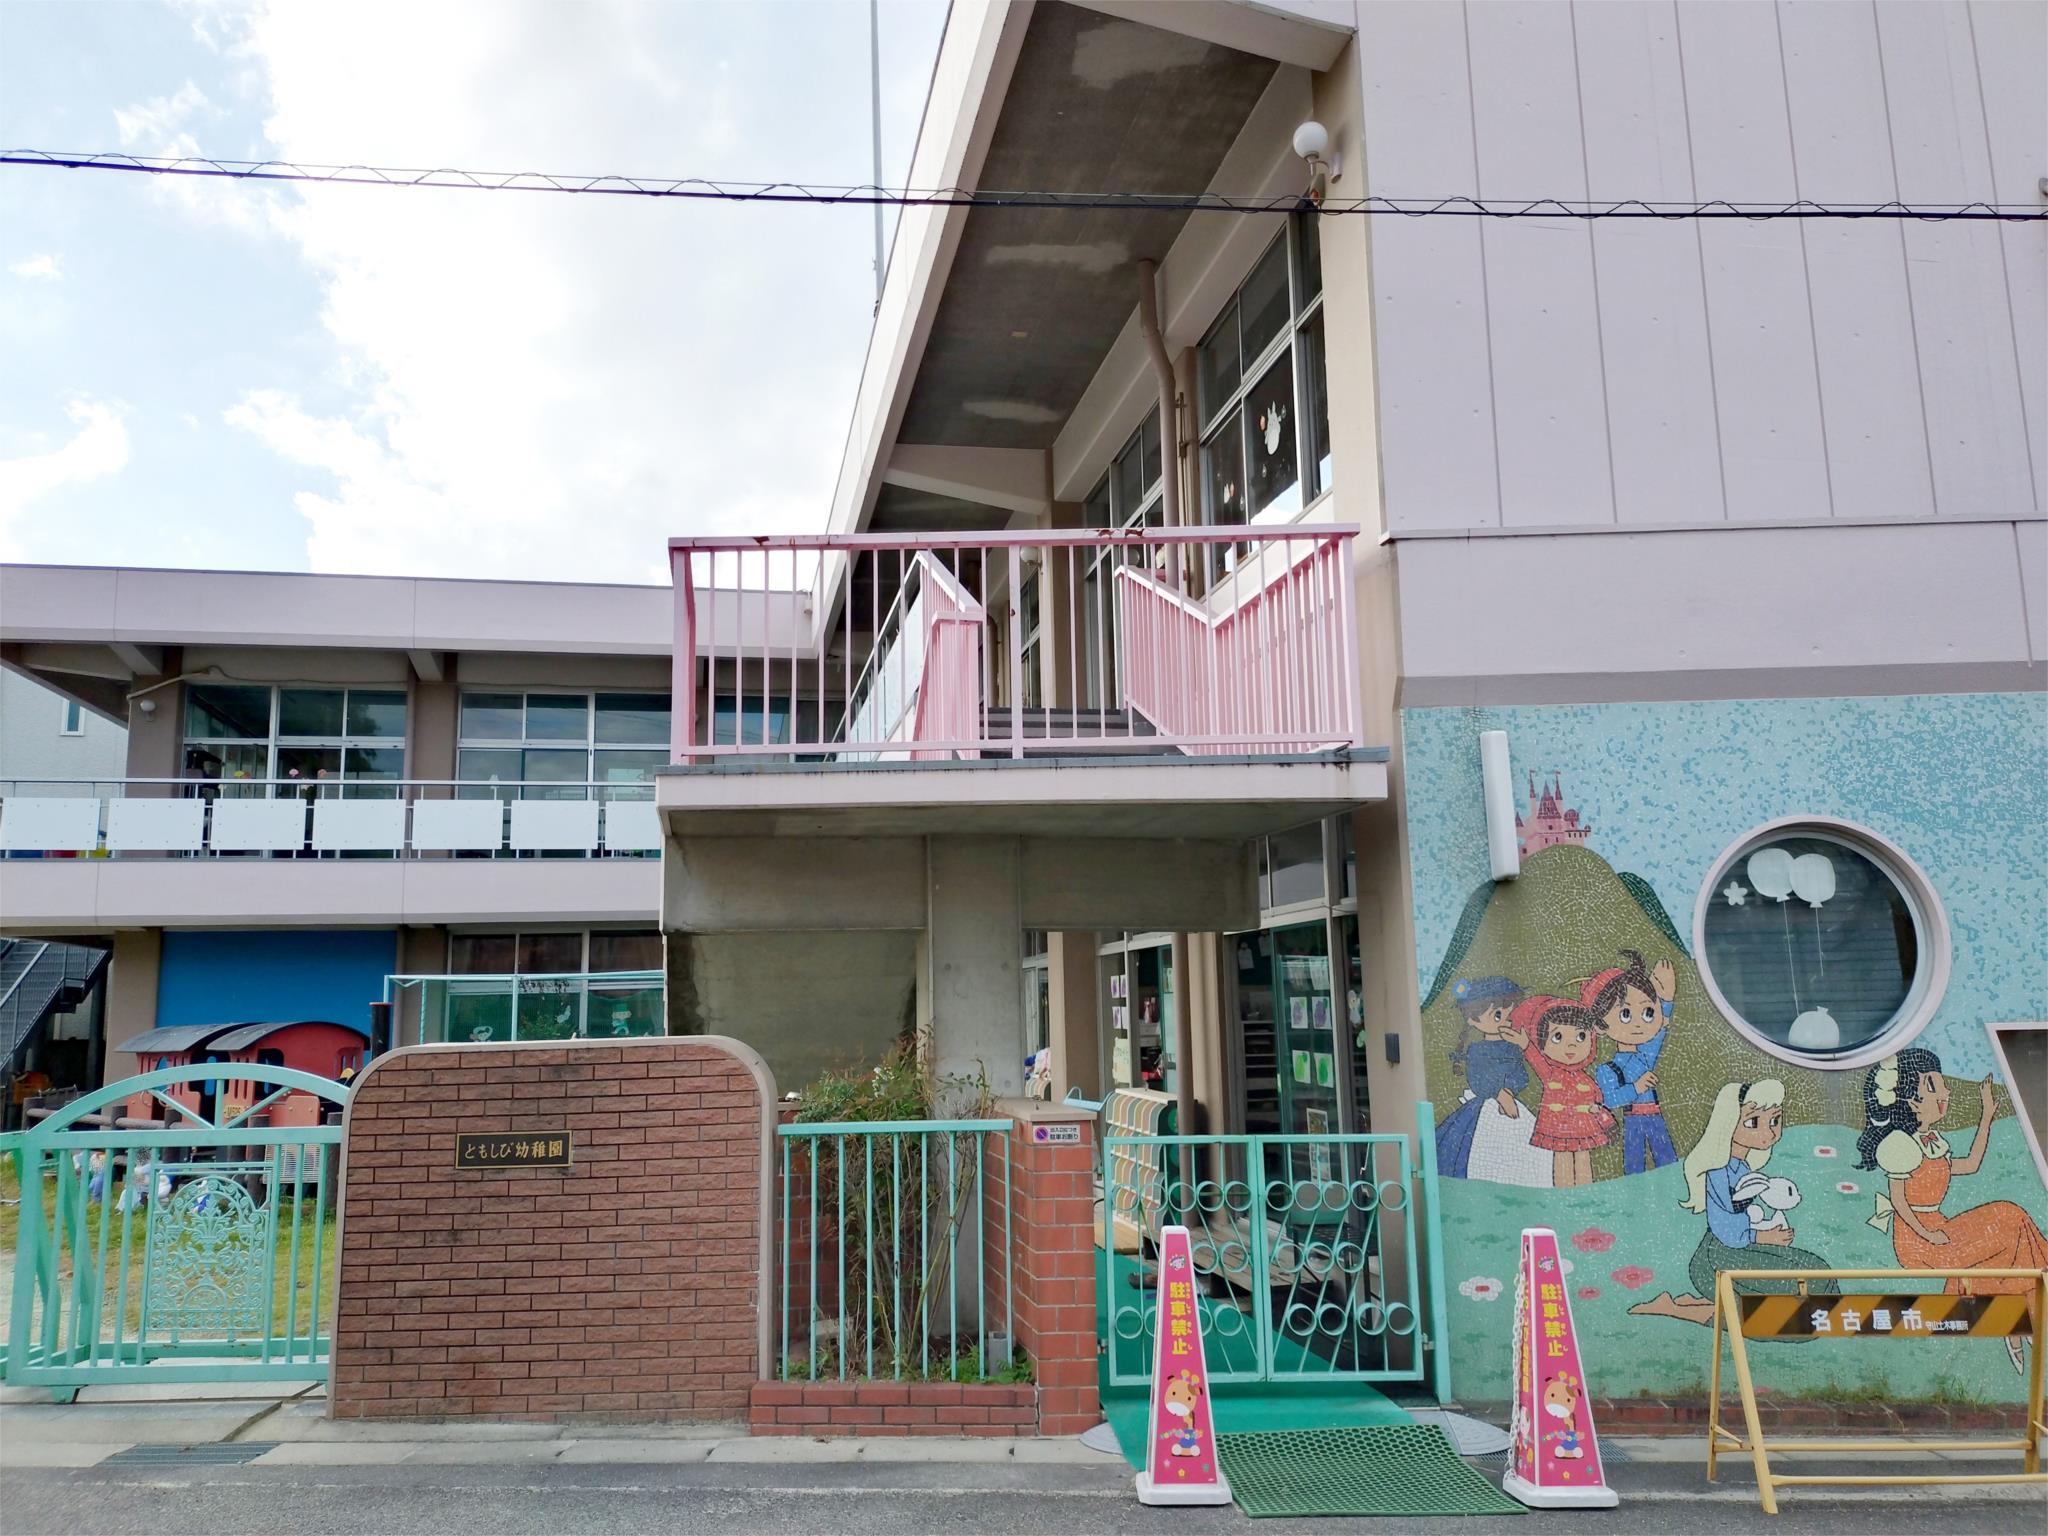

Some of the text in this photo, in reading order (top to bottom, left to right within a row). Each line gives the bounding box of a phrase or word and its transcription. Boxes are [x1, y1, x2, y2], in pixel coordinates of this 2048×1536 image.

[464, 1140, 563, 1159] ともしび幼稚園
[1170, 1281, 1188, 1355] 駐車禁止
[1541, 1283, 1564, 1357] 駐車禁止
[1811, 1308, 1922, 1331] 名古屋市
